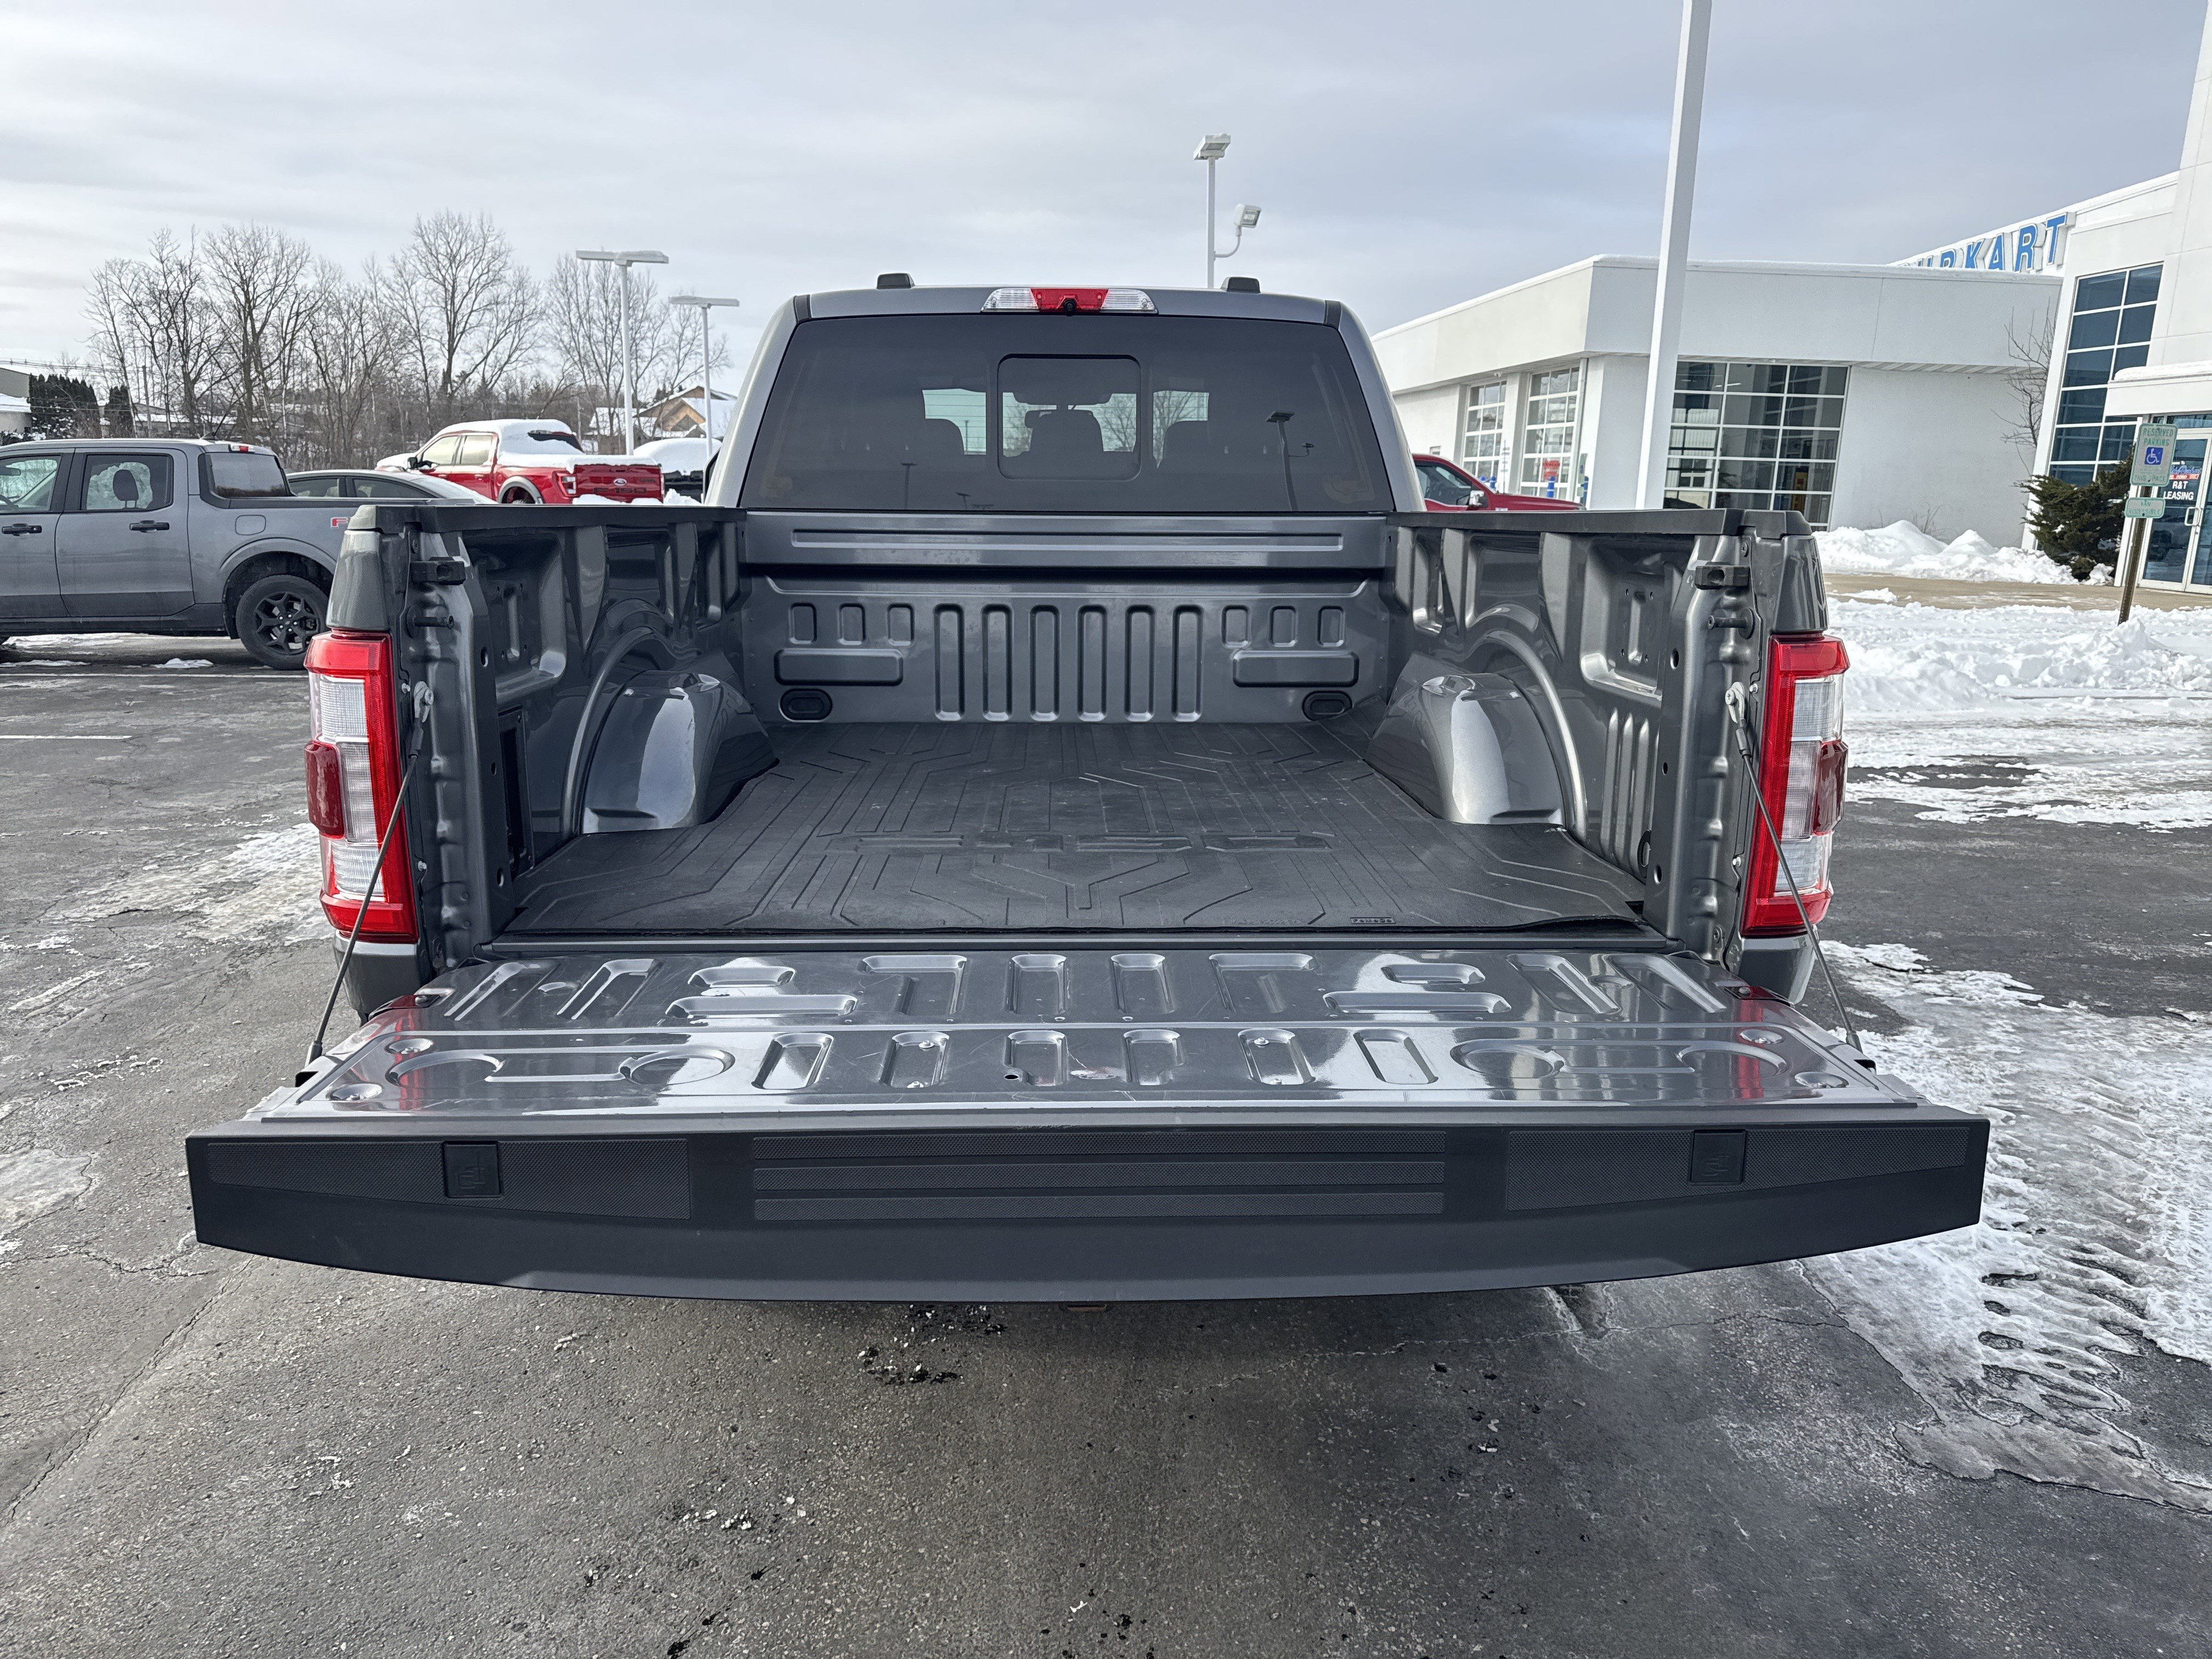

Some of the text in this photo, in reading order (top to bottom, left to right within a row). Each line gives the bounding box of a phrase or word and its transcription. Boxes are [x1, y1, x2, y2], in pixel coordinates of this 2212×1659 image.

[1916, 212, 2068, 273] RKART
[2143, 428, 2174, 437] RESERVED
[2163, 491, 2194, 500] LEASING
